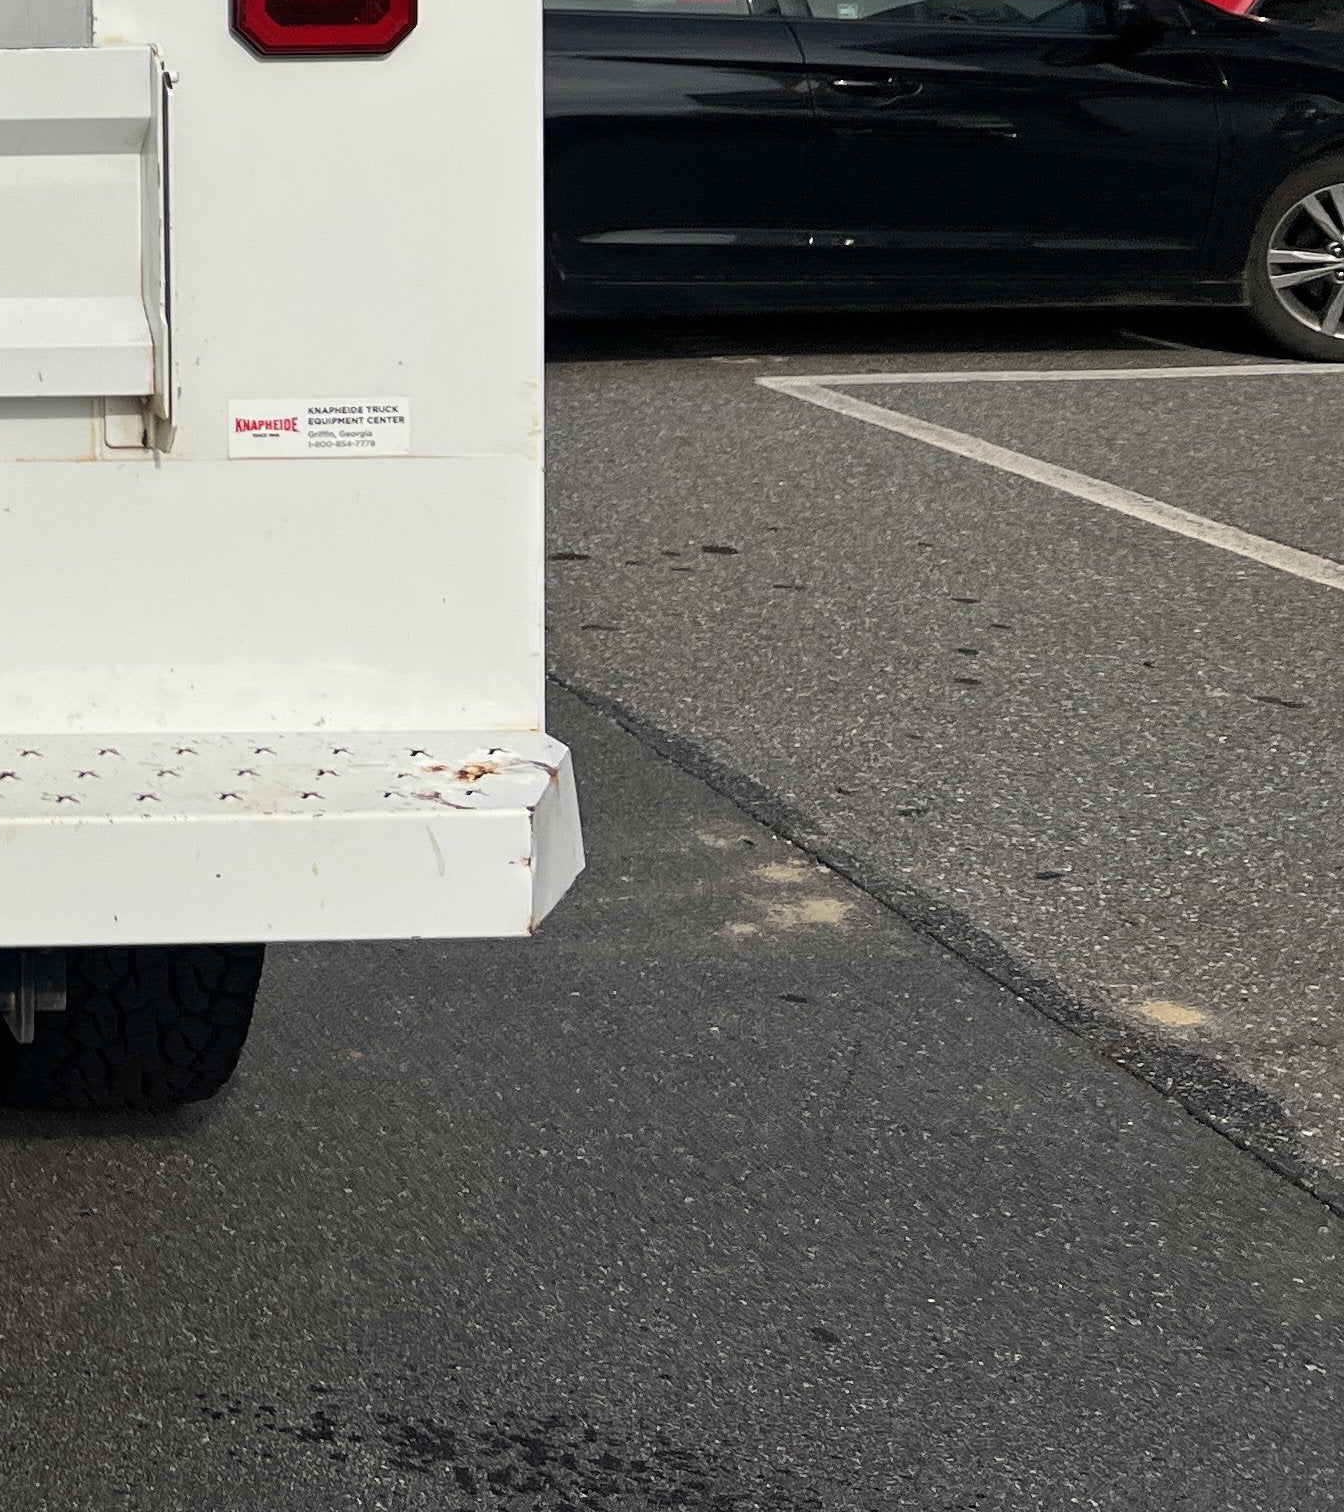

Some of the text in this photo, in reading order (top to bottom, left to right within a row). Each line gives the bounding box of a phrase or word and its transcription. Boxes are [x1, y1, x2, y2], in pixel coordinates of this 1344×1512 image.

[308, 405, 398, 414] KNAPHEIDE TRUCK
[235, 417, 300, 432] KNAPHEIDE
[308, 416, 405, 425] EQUIPMENT CENTER
[339, 430, 373, 438] Georgia
